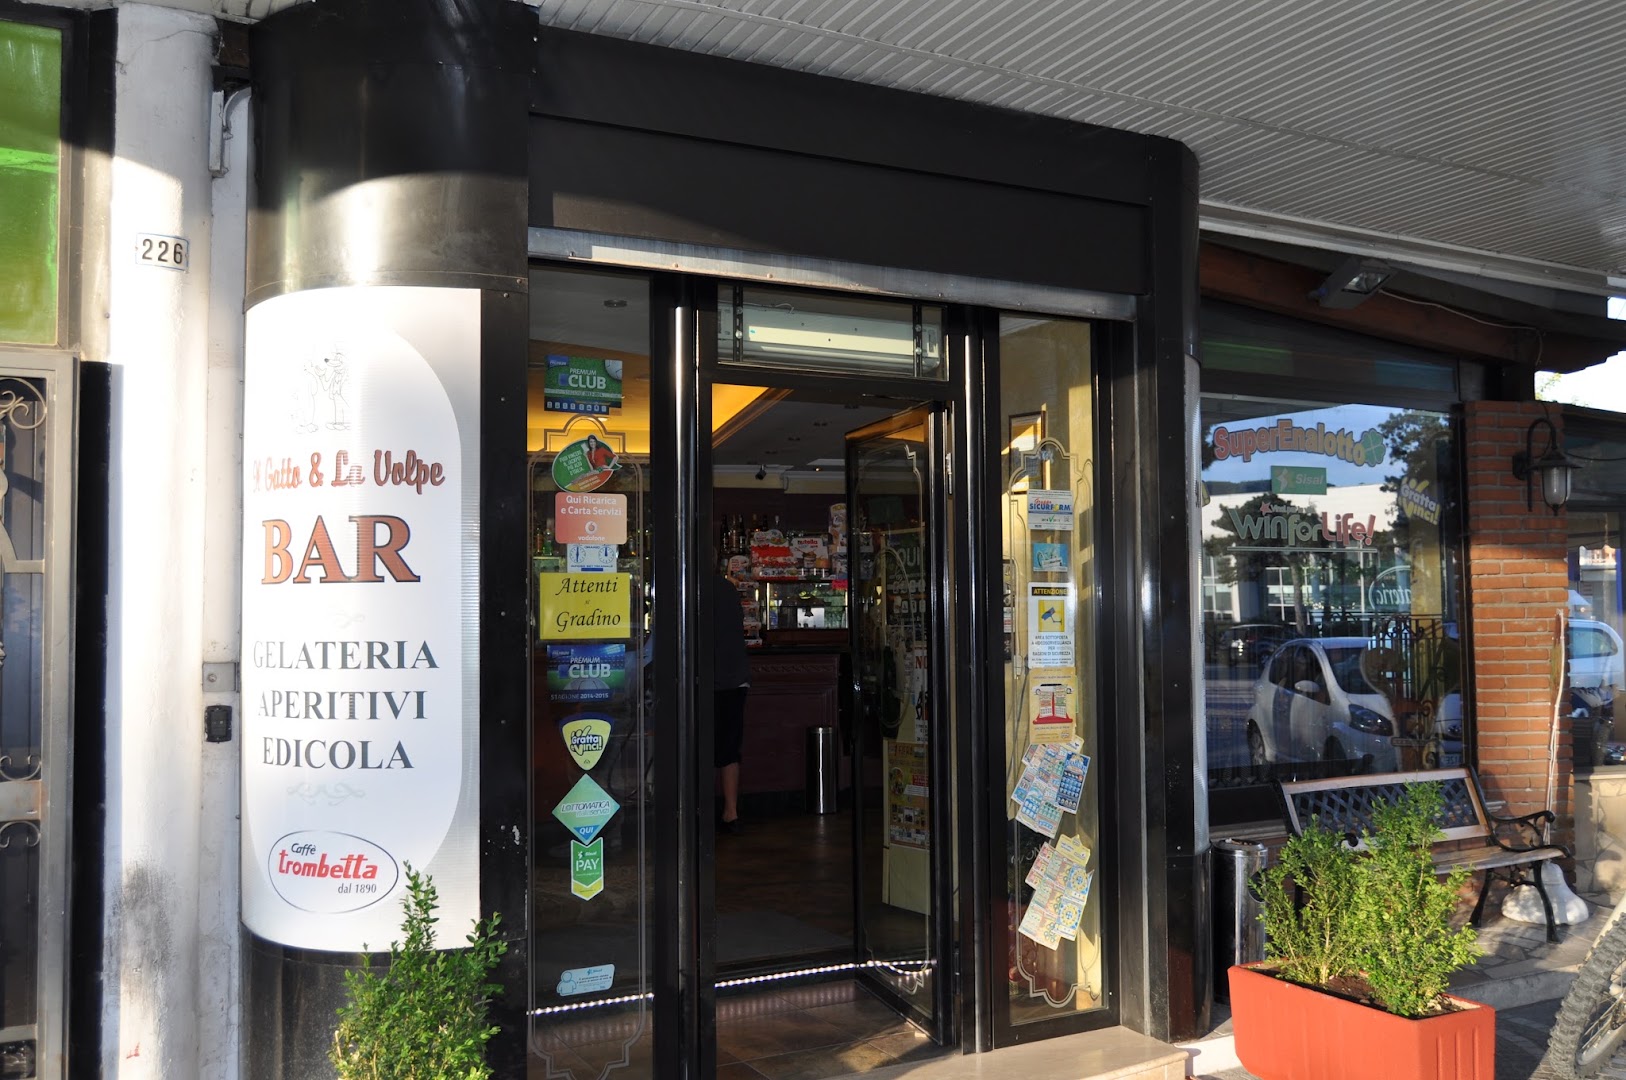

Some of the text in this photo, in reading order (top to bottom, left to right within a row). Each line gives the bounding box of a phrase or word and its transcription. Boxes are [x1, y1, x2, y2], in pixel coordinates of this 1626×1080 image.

[142, 238, 183, 265] 226
[568, 375, 607, 389] CLUB
[1213, 418, 1366, 466] SuperEnalotto
[264, 457, 303, 491] Gatto
[309, 452, 324, 487] &
[331, 449, 366, 487] La
[373, 449, 446, 495] Volpe
[1295, 474, 1324, 485] Sisal
[566, 495, 617, 505] Qui Ricarica
[1401, 484, 1437, 512] Gratta
[568, 506, 591, 515] Carta
[592, 506, 622, 516] Servizi
[261, 515, 421, 584] BAR
[555, 577, 619, 595] Attenti
[556, 608, 621, 632] Gradino
[253, 639, 440, 669] GELATERIA
[568, 663, 611, 678] CLUB
[258, 690, 429, 720] APERITIVI
[571, 733, 600, 745] Gratta
[262, 737, 415, 770] EDICOLA
[562, 800, 610, 812] LOTTOMATICA
[579, 827, 594, 835] QUI
[291, 842, 316, 856] Caffè
[278, 849, 379, 879] trombetta
[575, 858, 600, 871] PAY
[337, 883, 377, 894] dal 1890
